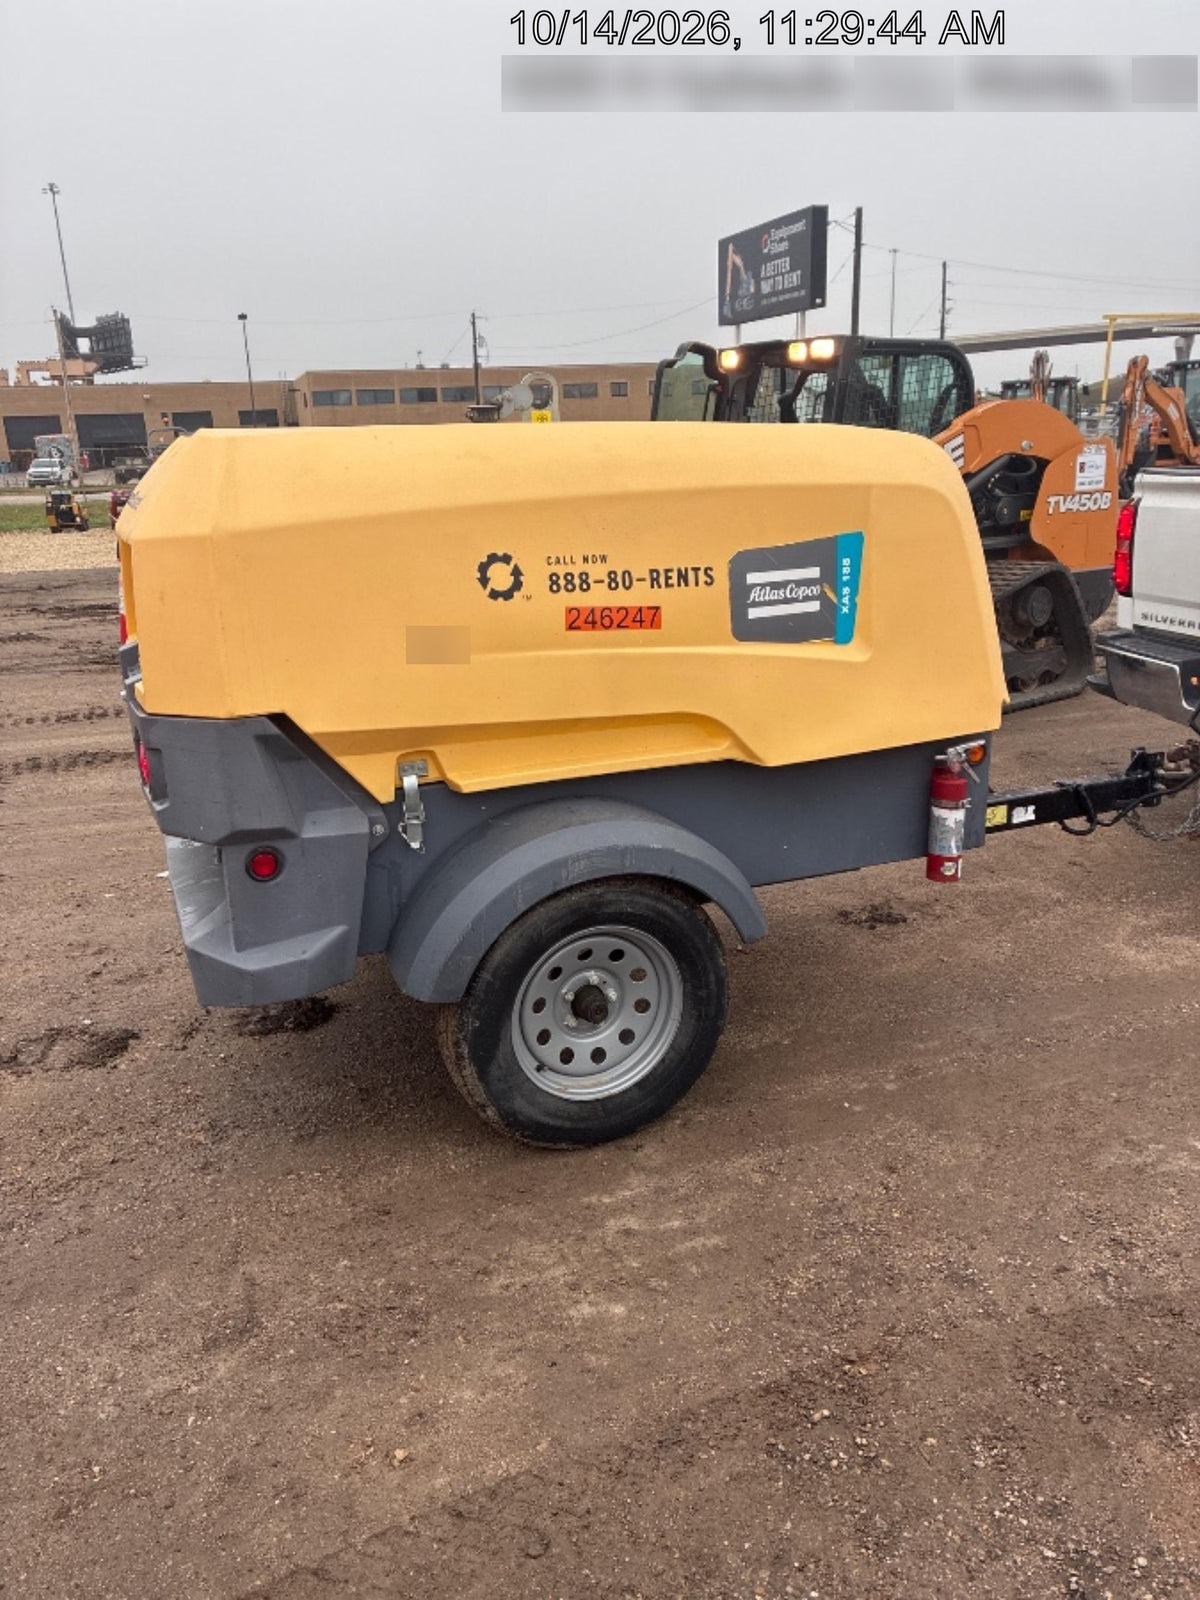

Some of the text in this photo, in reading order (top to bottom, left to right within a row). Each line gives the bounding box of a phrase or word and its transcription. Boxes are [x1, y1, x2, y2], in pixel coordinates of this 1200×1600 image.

[766, 257, 790, 276] BETTER
[775, 274, 783, 291] TO
[783, 269, 801, 289] RENT
[1047, 491, 1112, 515] TV450B
[547, 554, 608, 566] CALL NOW
[548, 566, 716, 594] 888-80-RENTS
[746, 582, 821, 603] Atlas Copco
[841, 586, 851, 615] XAS
[567, 606, 661, 630] 246247
[1141, 612, 1200, 629] SILVERA
